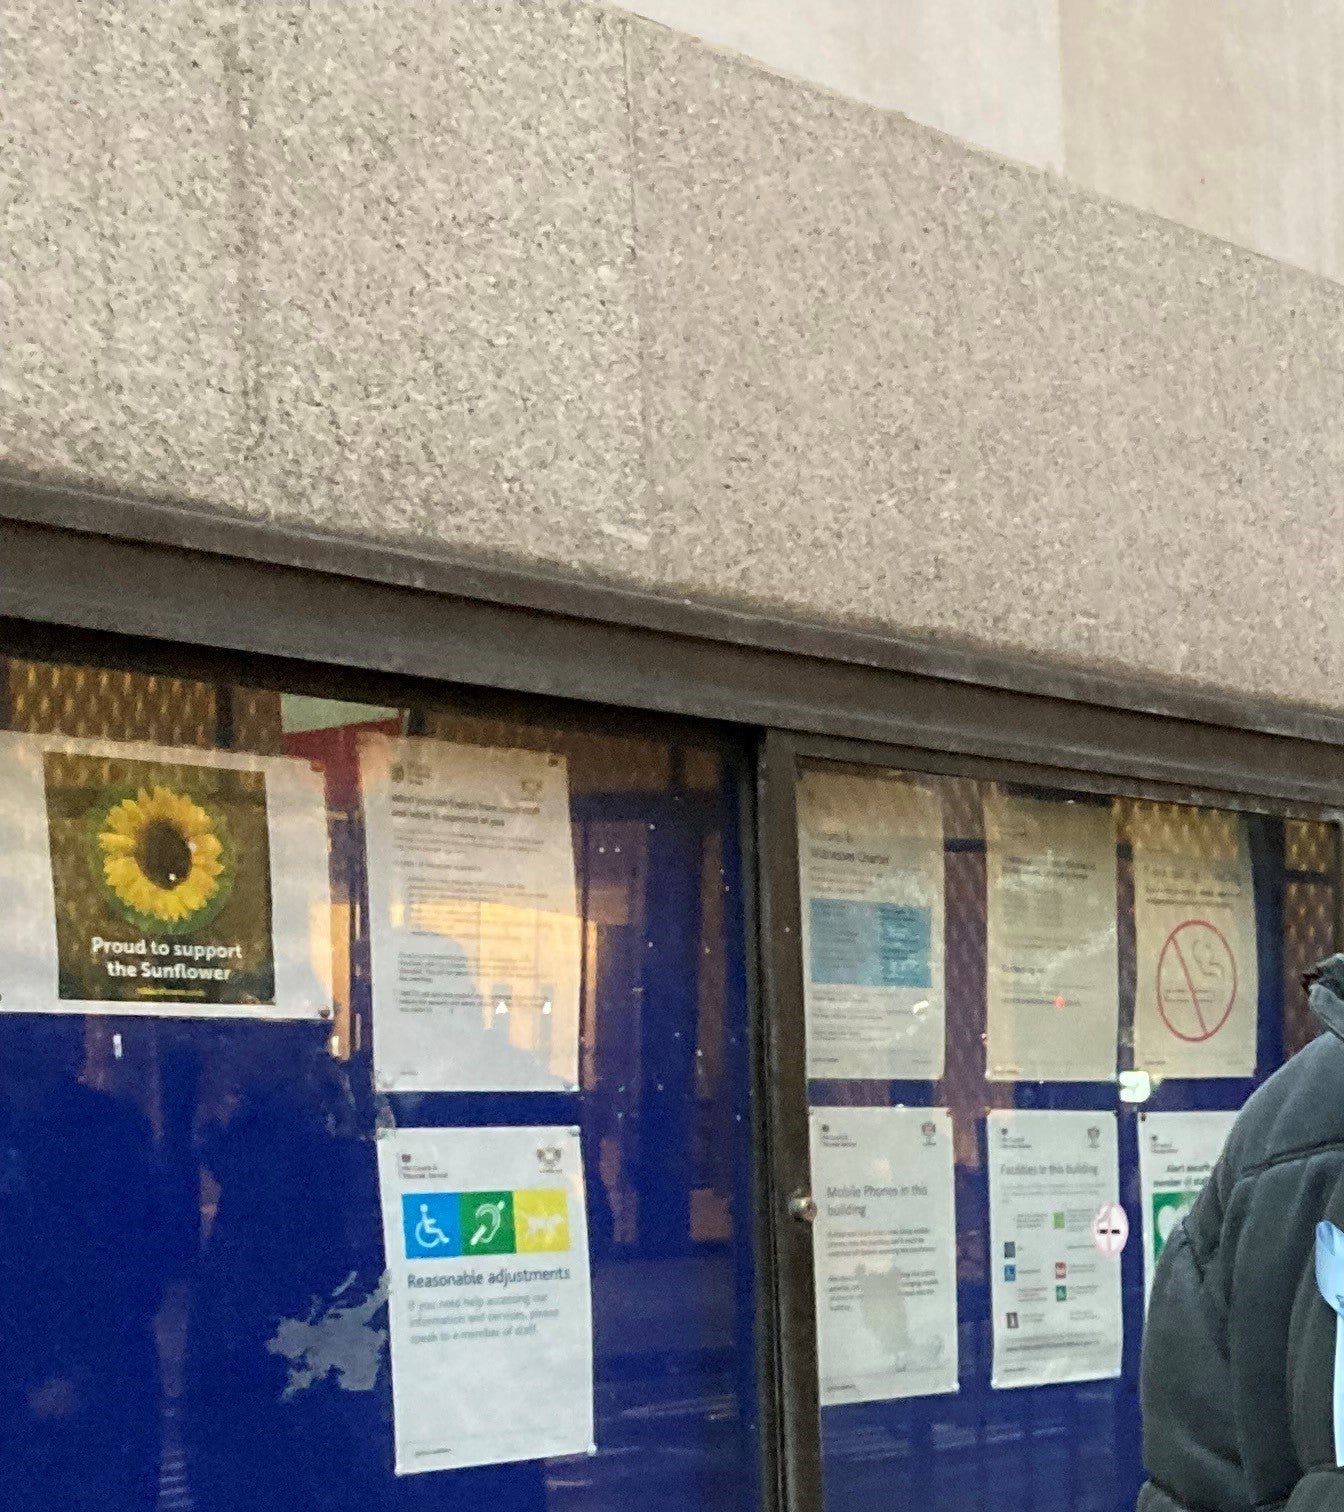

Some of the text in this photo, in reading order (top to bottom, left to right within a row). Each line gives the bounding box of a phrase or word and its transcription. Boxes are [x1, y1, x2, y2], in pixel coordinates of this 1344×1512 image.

[91, 936, 243, 961] Proud to support
[107, 960, 231, 981] the Sunflower
[826, 1183, 861, 1198] Mobile
[407, 1266, 571, 1289] Reasonable adjustments
